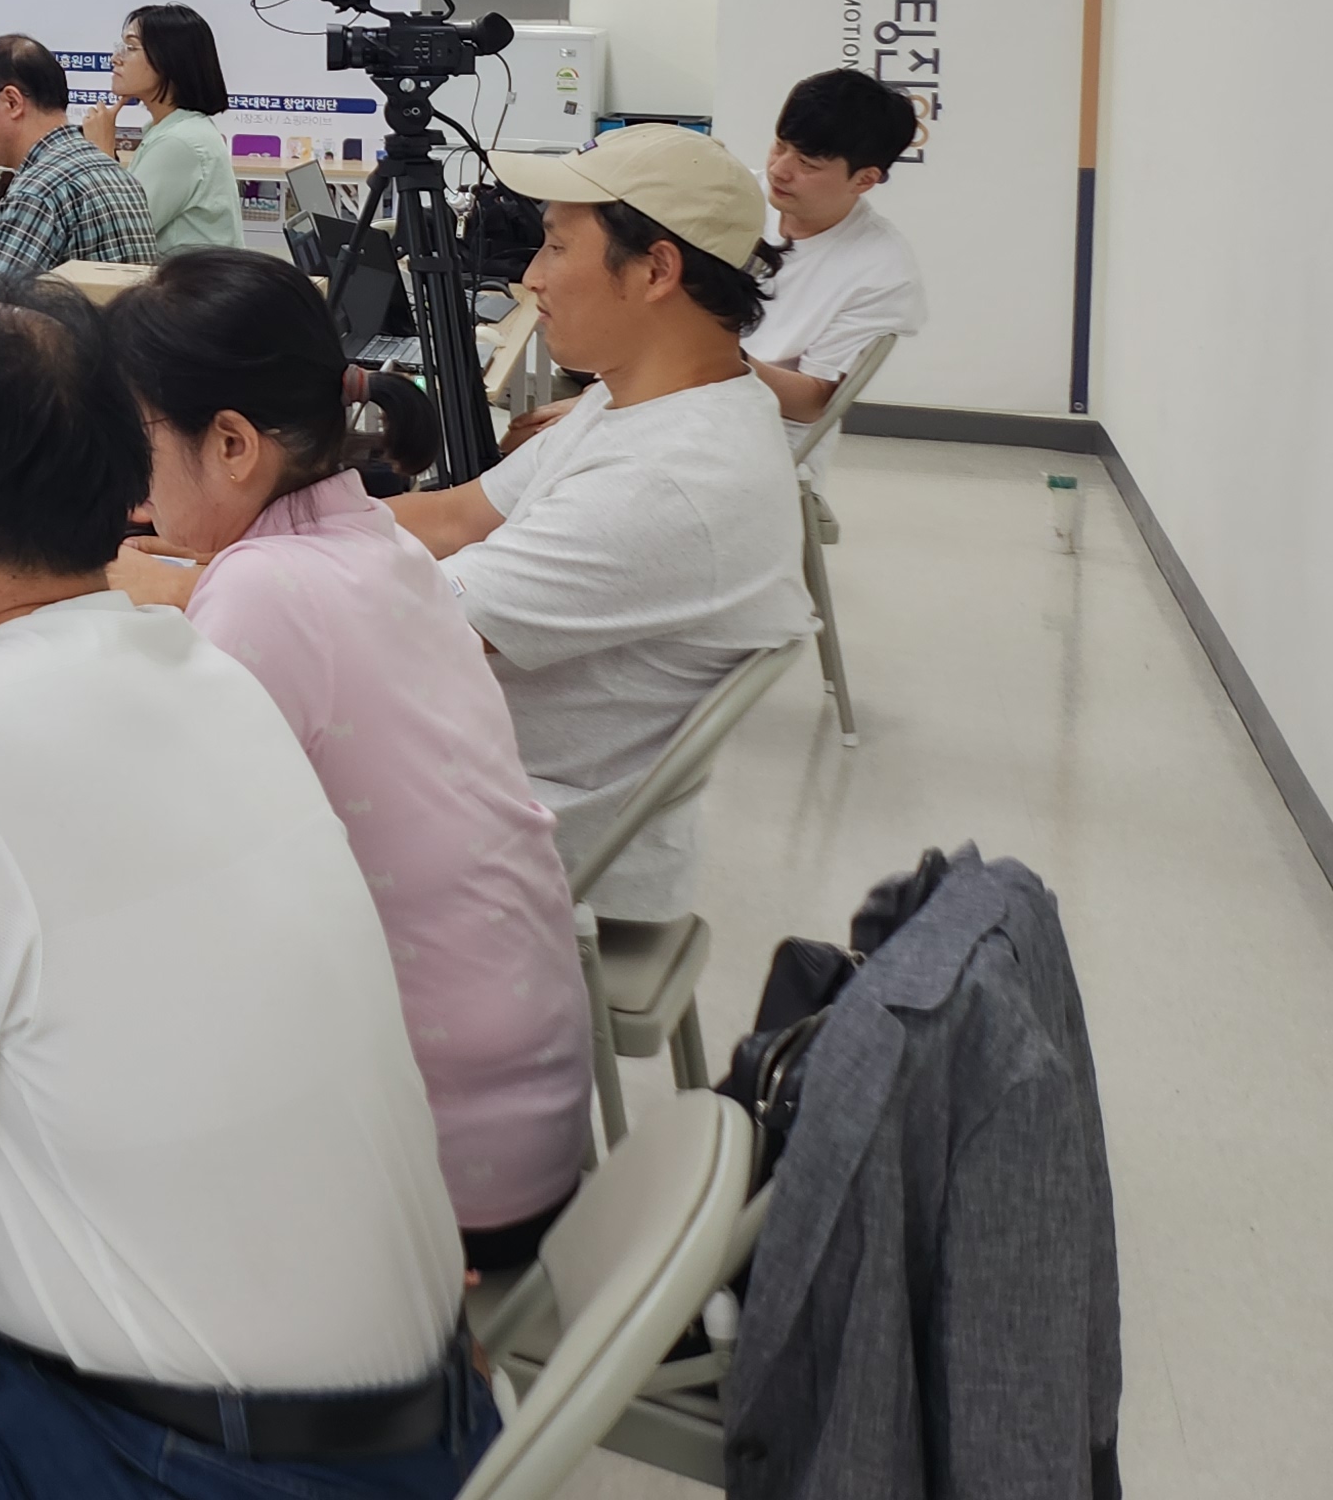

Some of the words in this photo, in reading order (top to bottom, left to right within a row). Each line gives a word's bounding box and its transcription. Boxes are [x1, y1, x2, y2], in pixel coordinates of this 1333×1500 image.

[55, 54, 96, 69] 흥원의
[68, 90, 123, 104] 한국표준협
[227, 96, 281, 109] 단국대학교
[283, 98, 338, 111] 창업지원단
